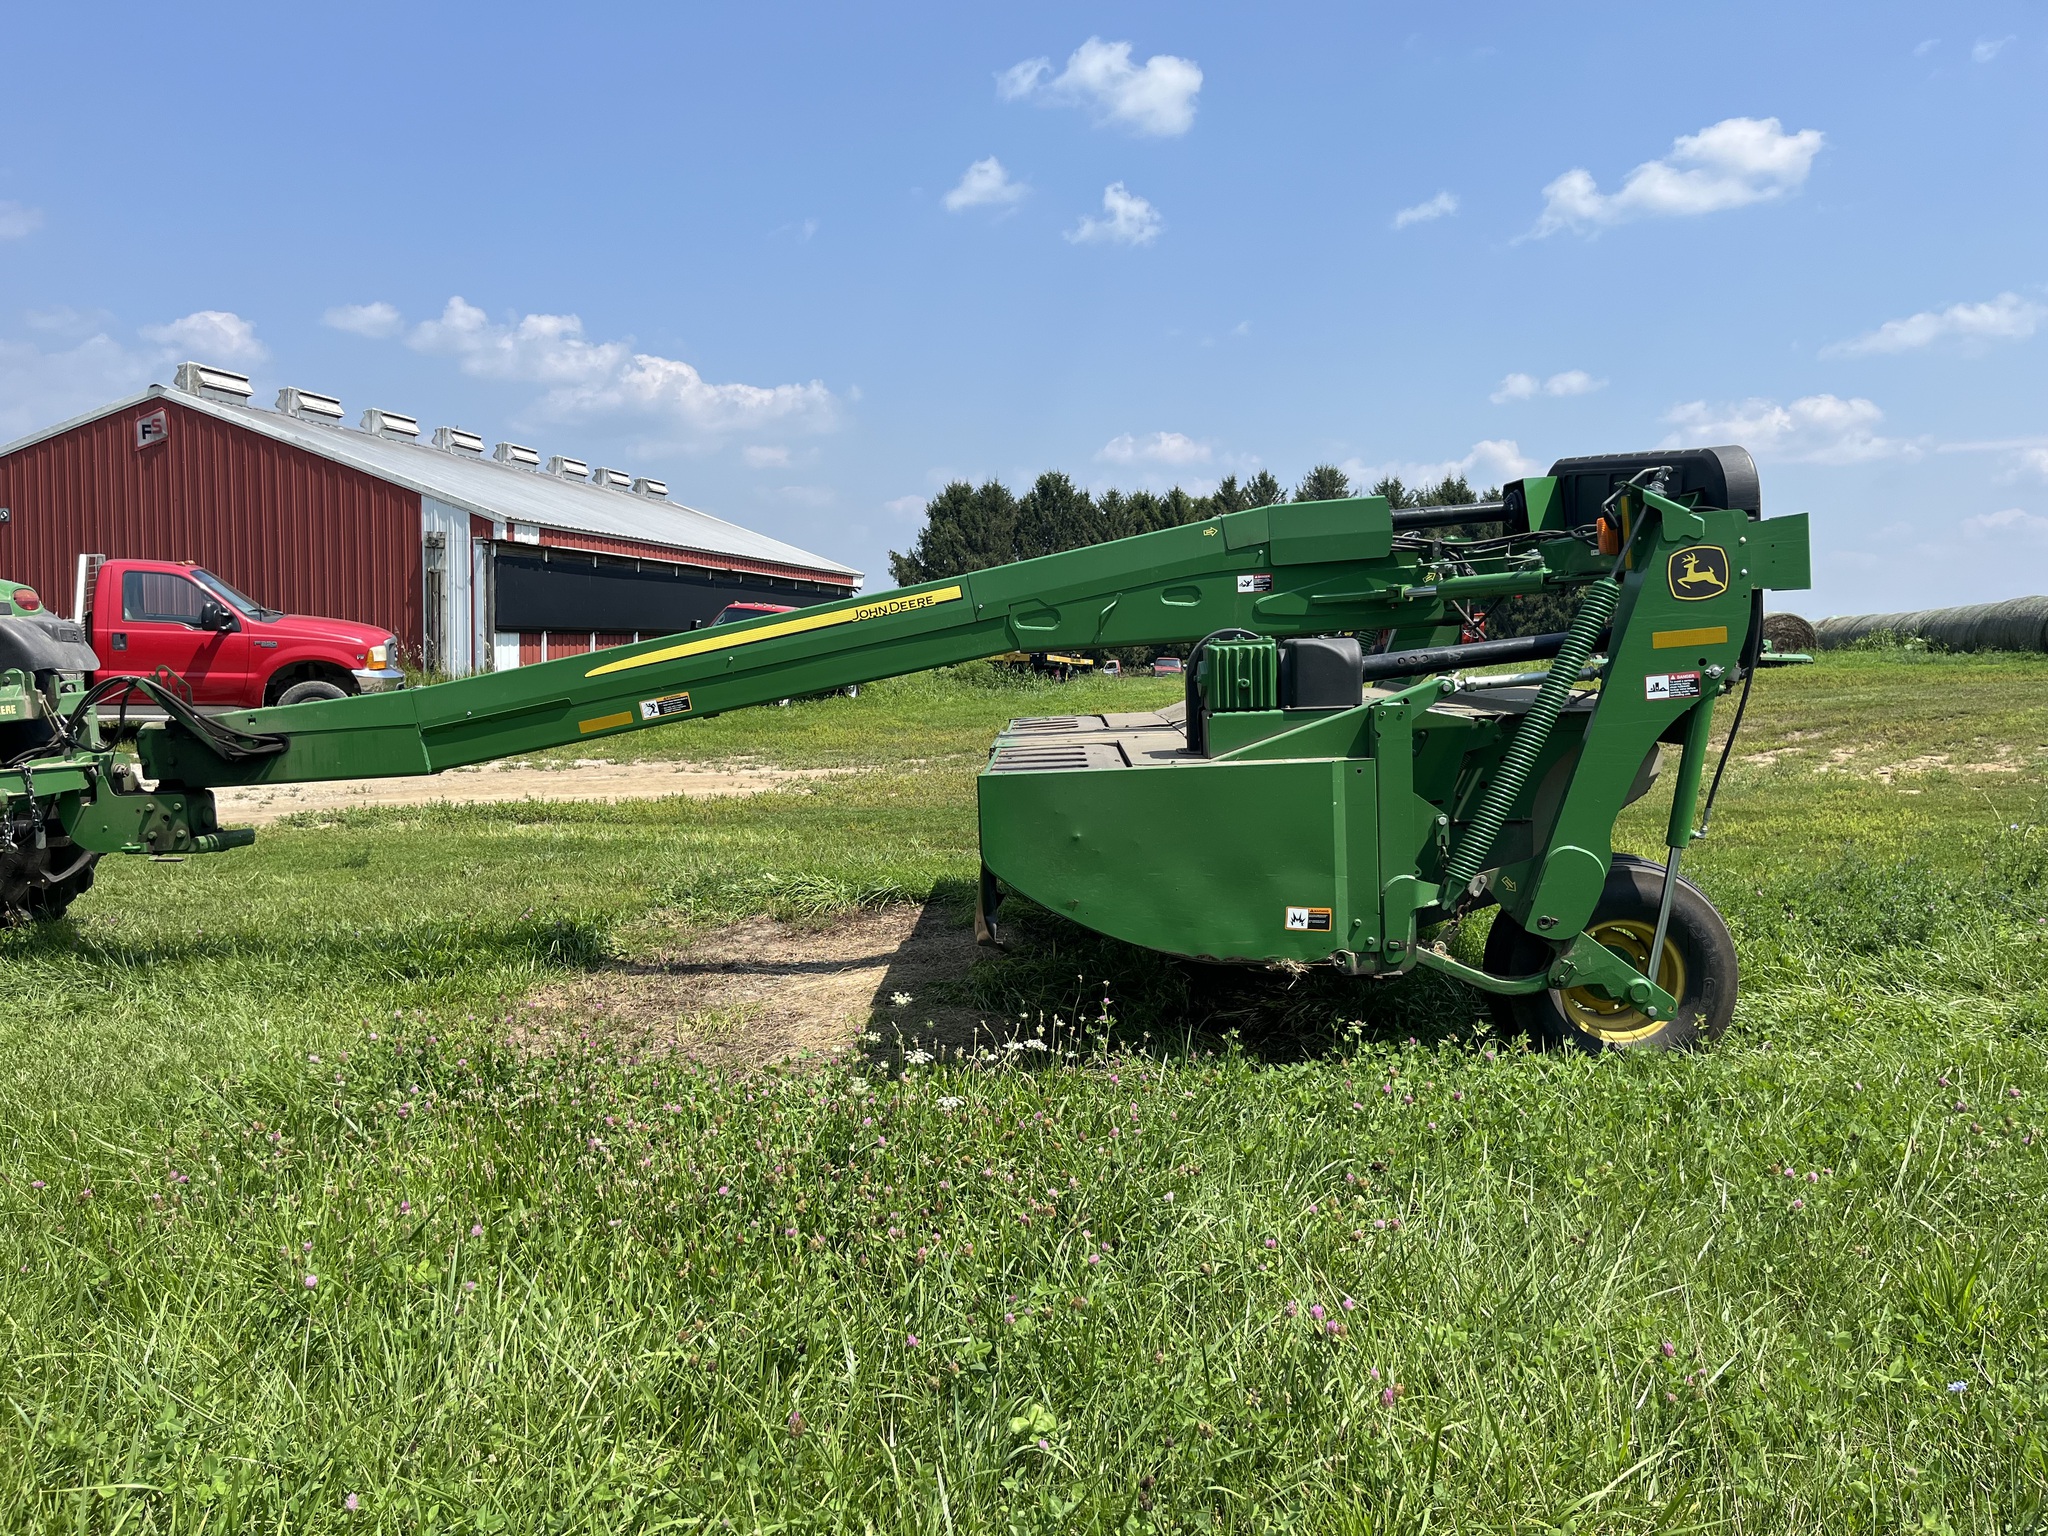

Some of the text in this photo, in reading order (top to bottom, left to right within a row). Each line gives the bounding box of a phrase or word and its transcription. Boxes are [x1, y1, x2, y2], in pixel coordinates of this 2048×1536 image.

[142, 418, 163, 440] FS
[852, 595, 934, 621] JOHN DEERE
[0, 705, 16, 714] ERE
